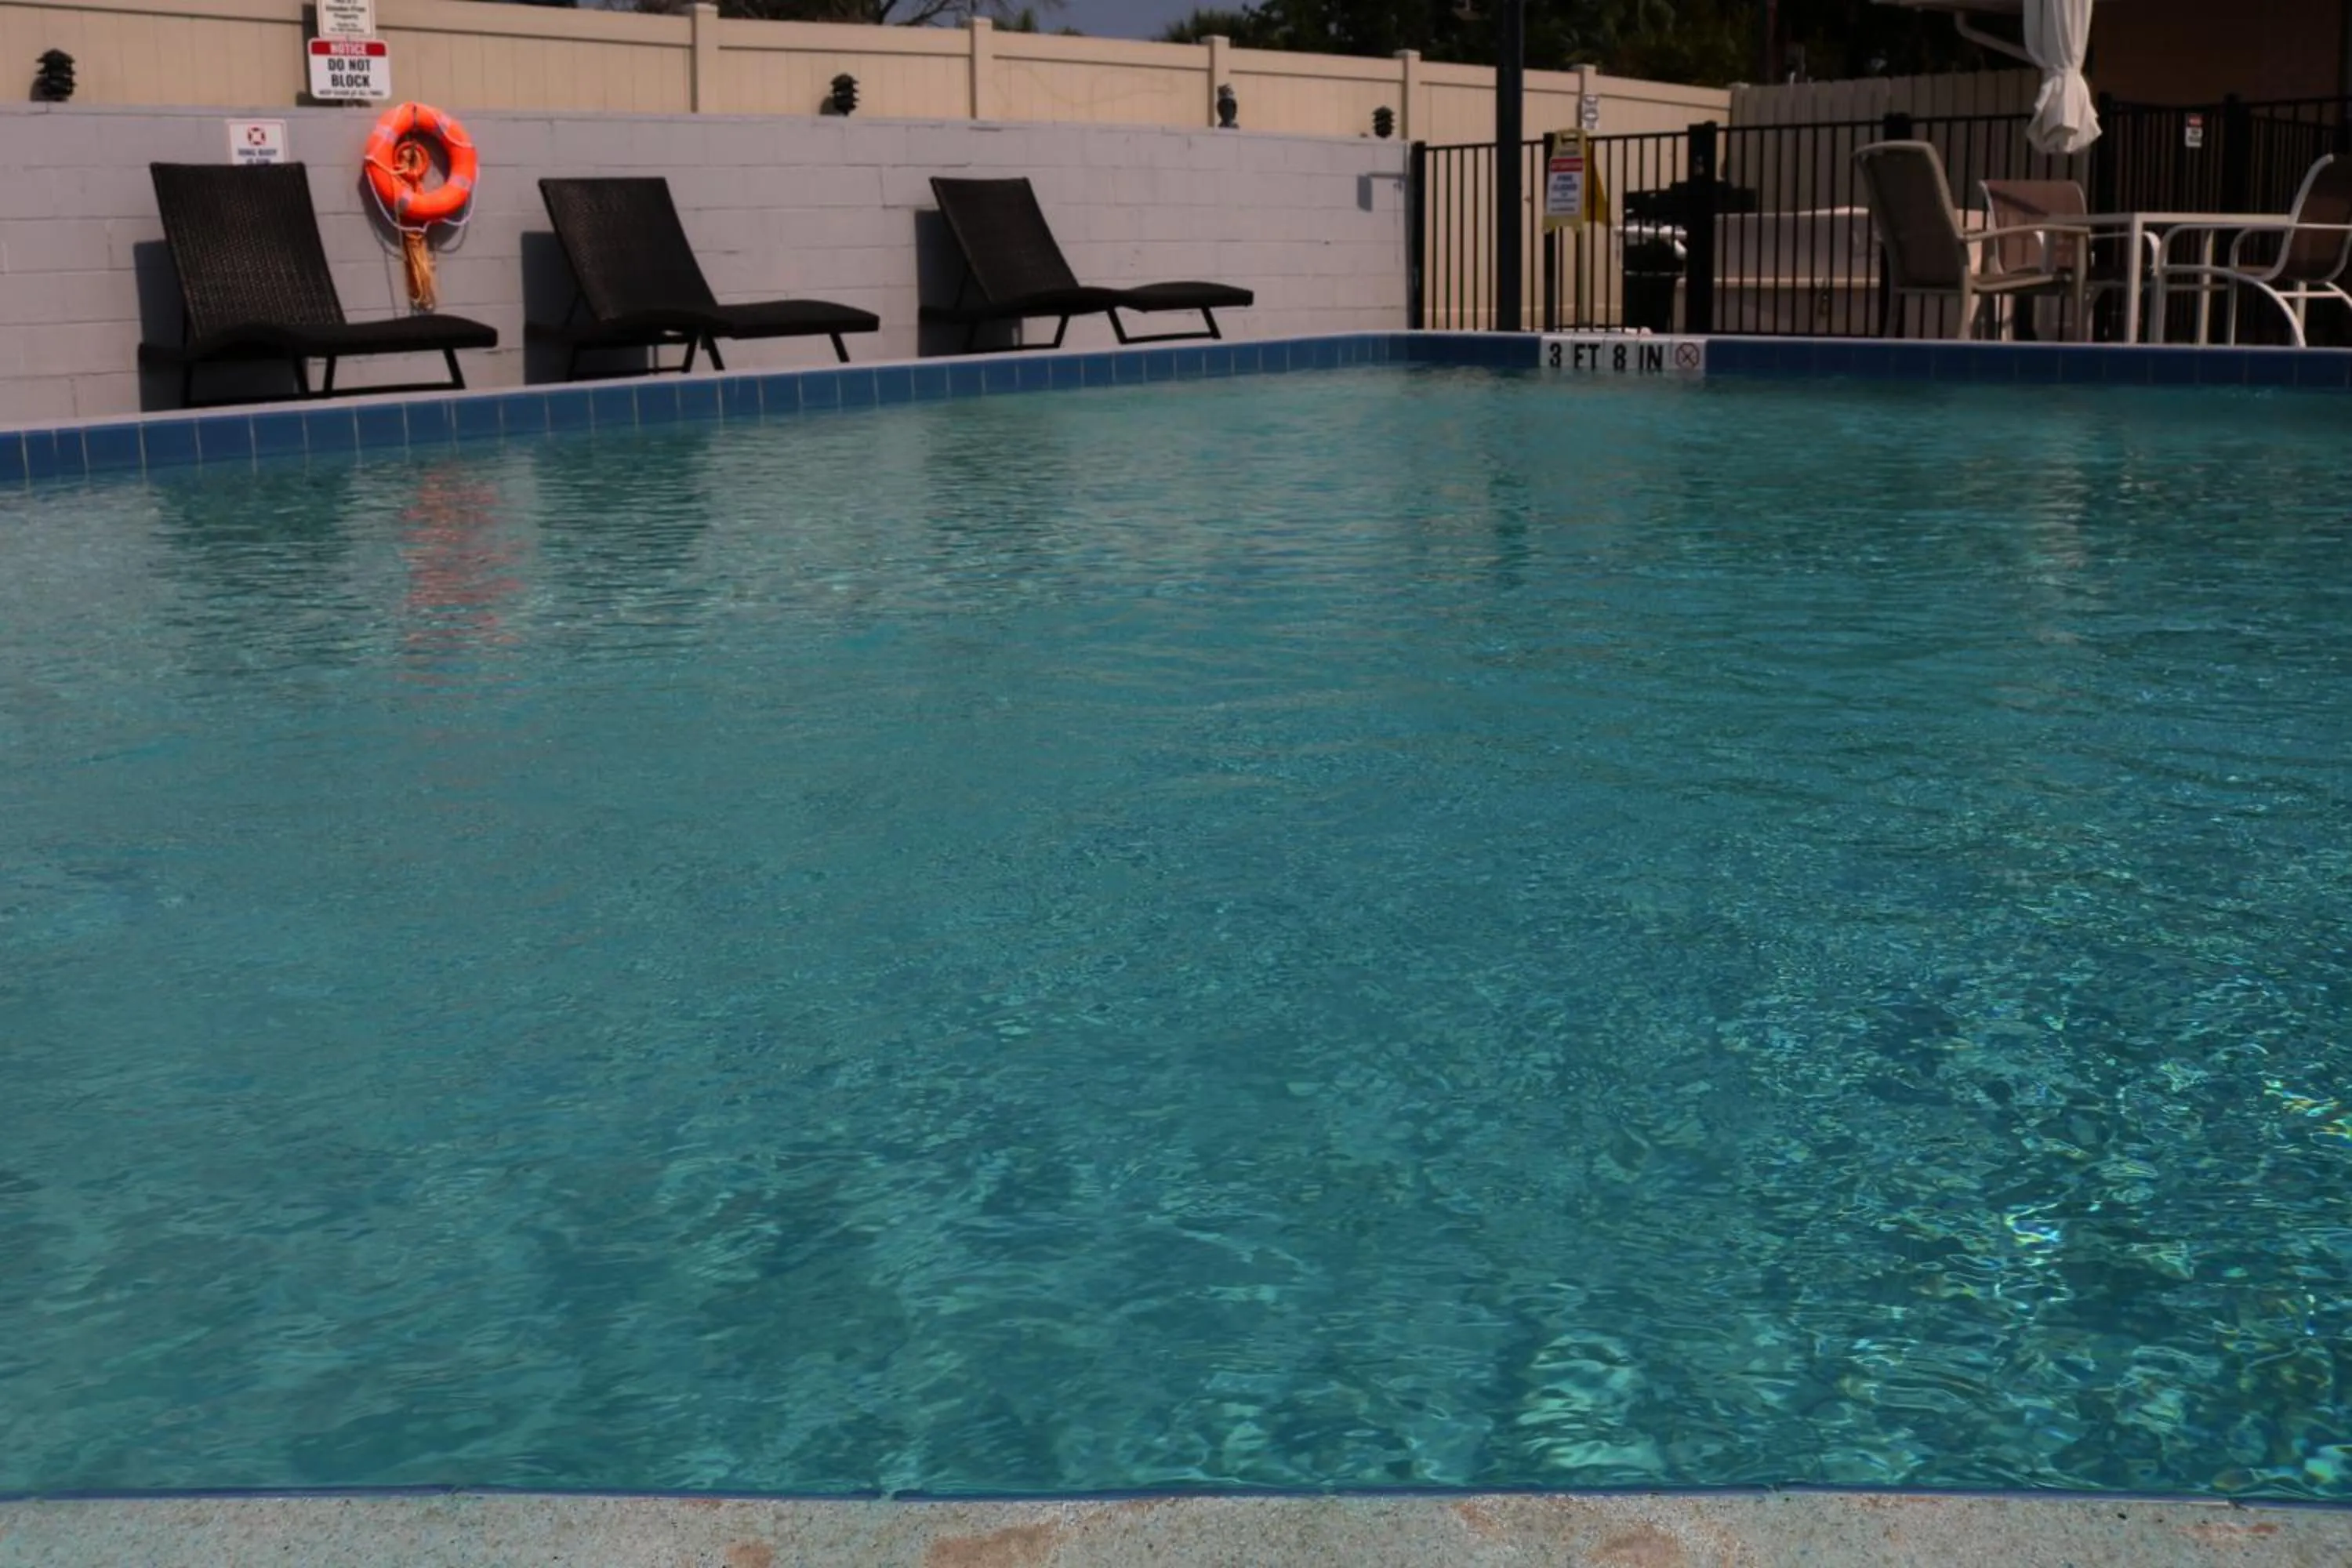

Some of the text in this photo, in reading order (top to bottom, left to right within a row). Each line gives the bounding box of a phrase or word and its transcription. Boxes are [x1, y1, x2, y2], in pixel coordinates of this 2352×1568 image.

[330, 42, 366, 55] NOTICE
[328, 58, 370, 71] DO NOT
[331, 74, 370, 88] BLOCK
[1549, 342, 1663, 372] 3 FT 8 IN
